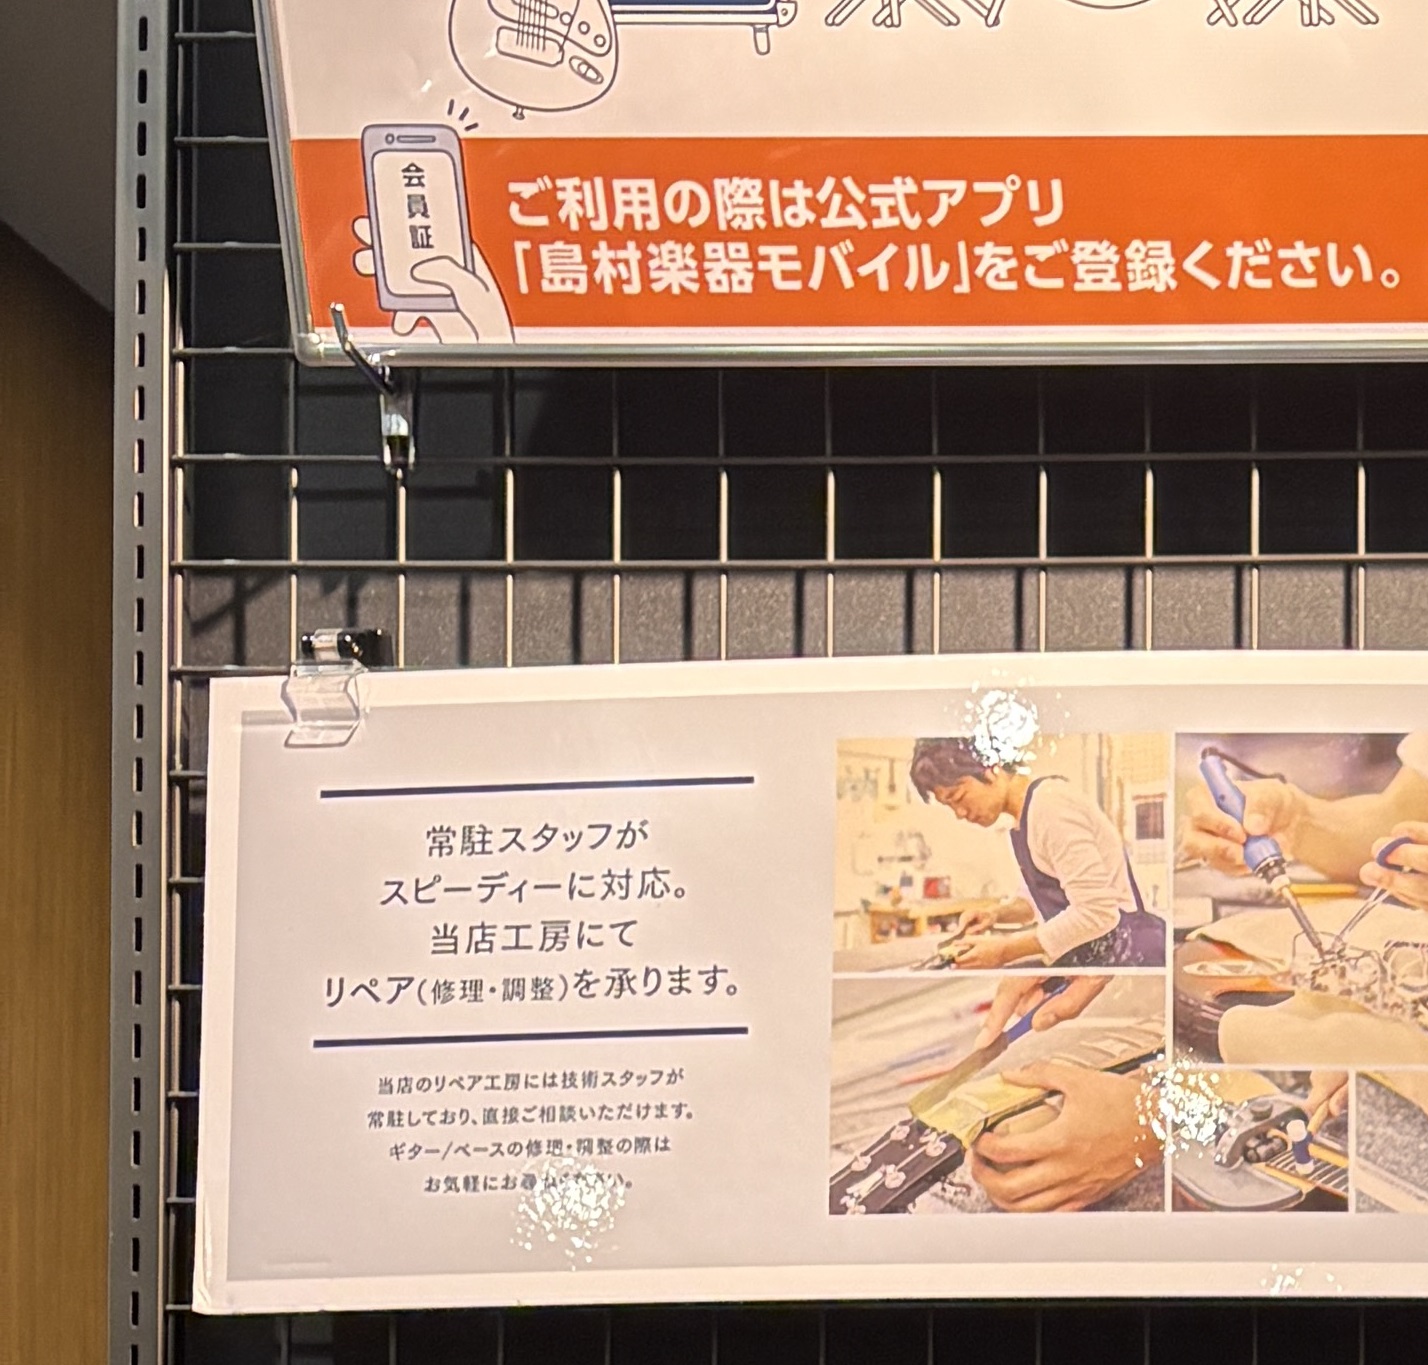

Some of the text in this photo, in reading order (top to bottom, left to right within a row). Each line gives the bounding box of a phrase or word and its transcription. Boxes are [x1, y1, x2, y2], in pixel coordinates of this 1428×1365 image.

[400, 162, 435, 252] 会員証
[508, 174, 1065, 232] ご利用の際は公式アプリ
[512, 237, 1401, 296] 「島村楽器モバイル」をご登録ください。
[425, 819, 650, 860] 常駐スタッフが
[380, 866, 689, 907] スピーディーに対応。
[429, 919, 640, 956] 当店工房にて
[325, 964, 740, 1008] リペア(修理・調整)を承ります。
[378, 1067, 685, 1096] 当店のリペア工房には技術スタッフが
[367, 1101, 695, 1130] 常駐しており、直接ご相談いただけます。
